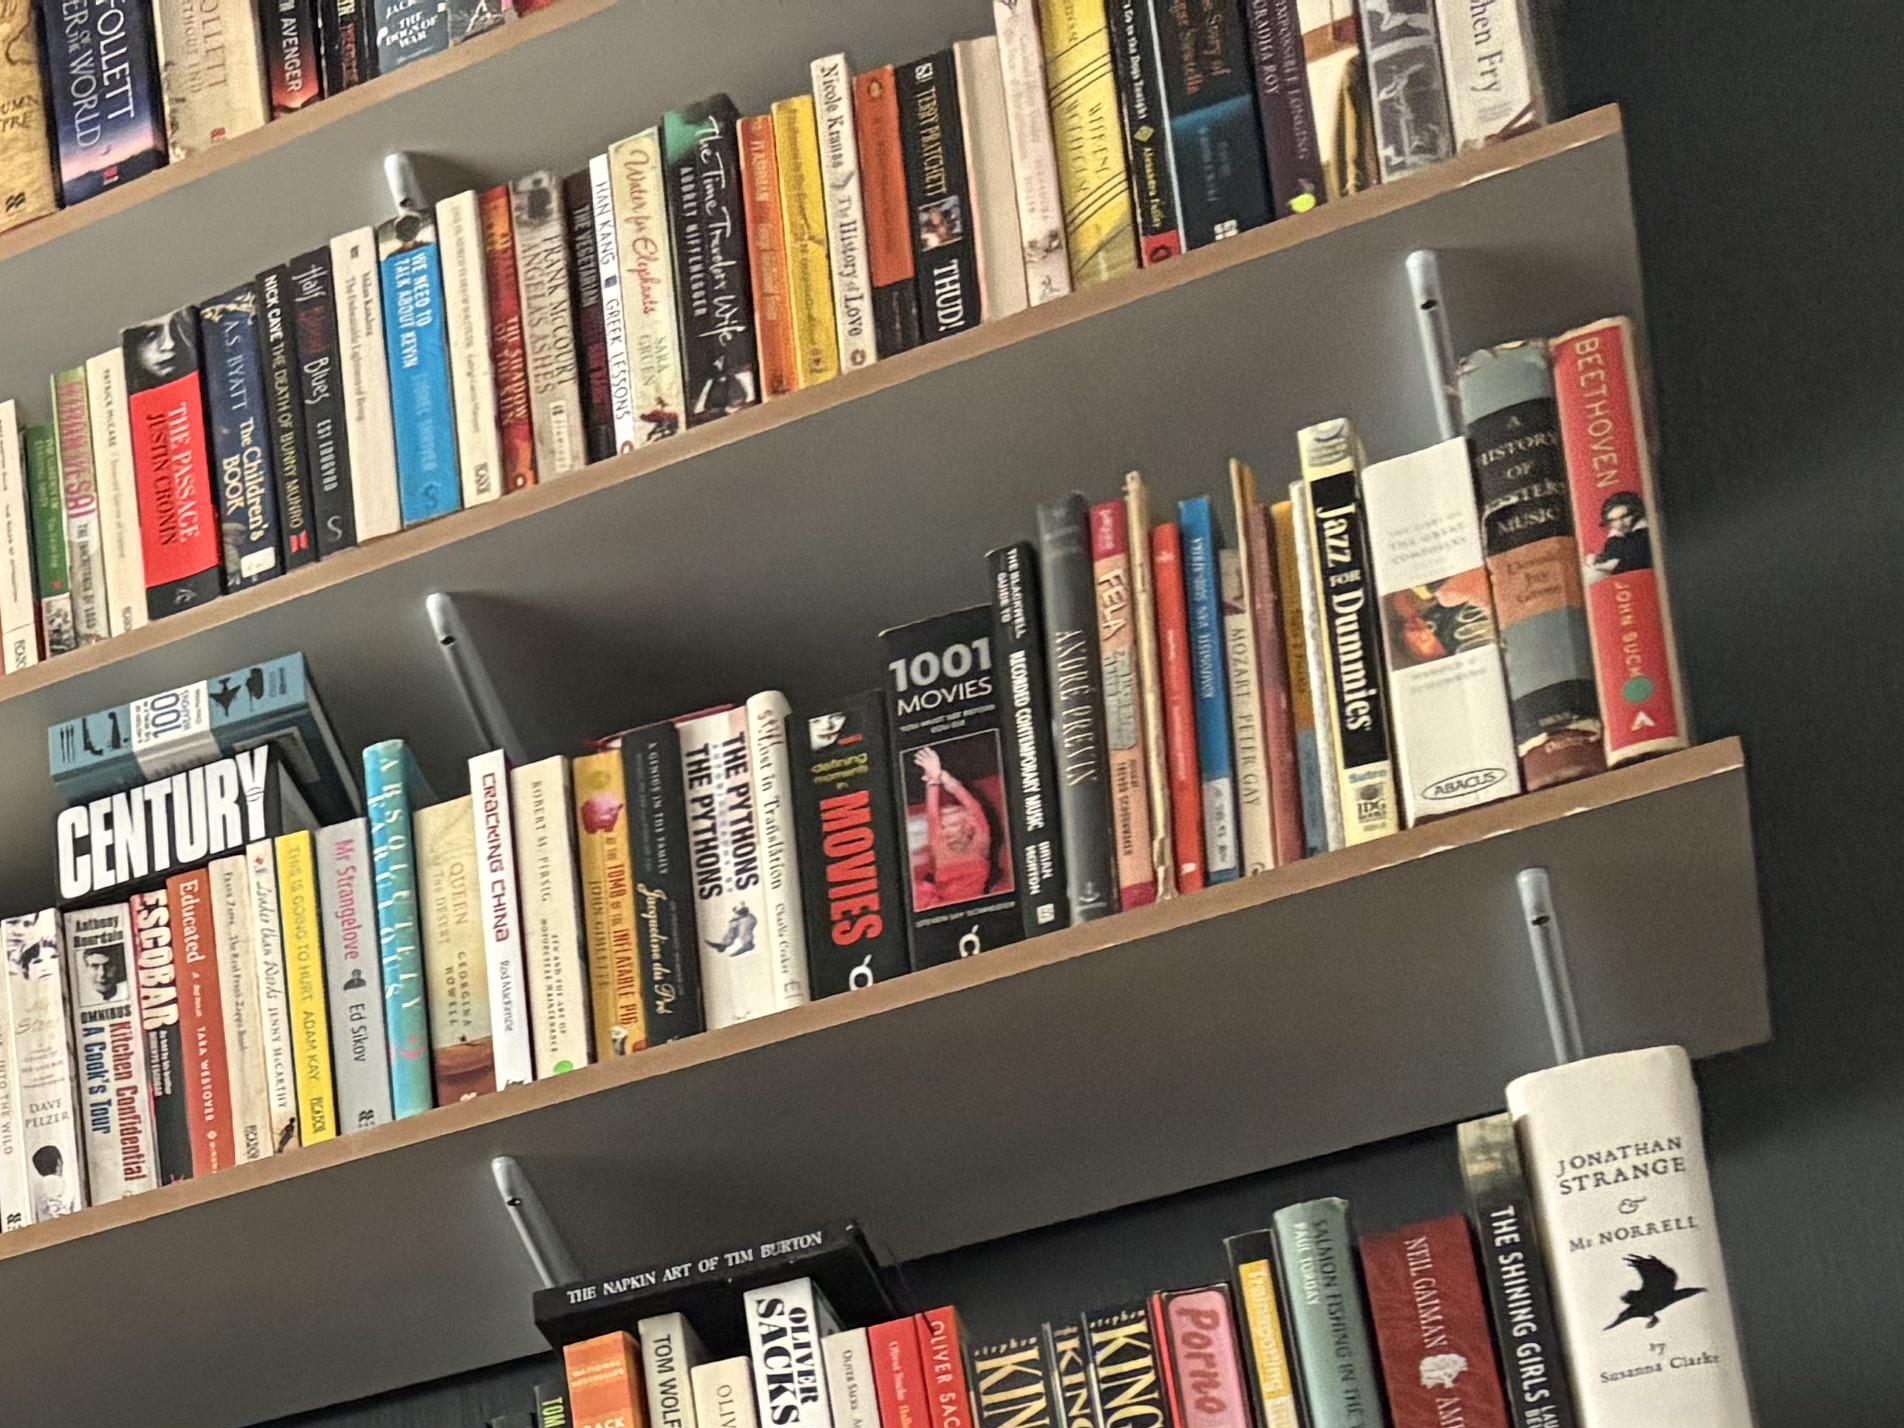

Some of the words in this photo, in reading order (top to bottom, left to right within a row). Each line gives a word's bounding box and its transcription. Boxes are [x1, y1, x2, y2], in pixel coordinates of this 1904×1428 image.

[70, 59, 104, 147] WORLD
[934, 258, 965, 333] THUD!
[1572, 336, 1618, 489] BEETHOVEN
[1315, 501, 1351, 569] Jazz
[1330, 569, 1361, 586] FOR
[888, 637, 993, 693] 1001
[1330, 589, 1372, 732] Dummies
[152, 692, 181, 738] 100
[897, 678, 993, 717] MOVIES
[1433, 769, 1498, 797] ABACUS
[57, 745, 270, 899] CENTURY
[820, 789, 883, 945] MOVIES
[178, 880, 199, 964] Educated
[1555, 1135, 1683, 1179] JONATHAN
[1558, 1157, 1686, 1197] STRANGE
[567, 1287, 596, 1304] THE
[603, 1272, 656, 1297] NAPKIN
[662, 1262, 691, 1283] ART
[697, 1256, 719, 1273] OF
[724, 1249, 754, 1269] TIM
[760, 1232, 823, 1260] BURTON
[1569, 1237, 1593, 1254] Mr
[1596, 1214, 1697, 1251] NORRELL
[755, 1298, 800, 1428] SACKS
[787, 1306, 821, 1406] OLIVER
[1176, 1305, 1226, 1415] Porno
[1599, 1363, 1664, 1385] Susanna
[1669, 1352, 1721, 1370] Clarke
